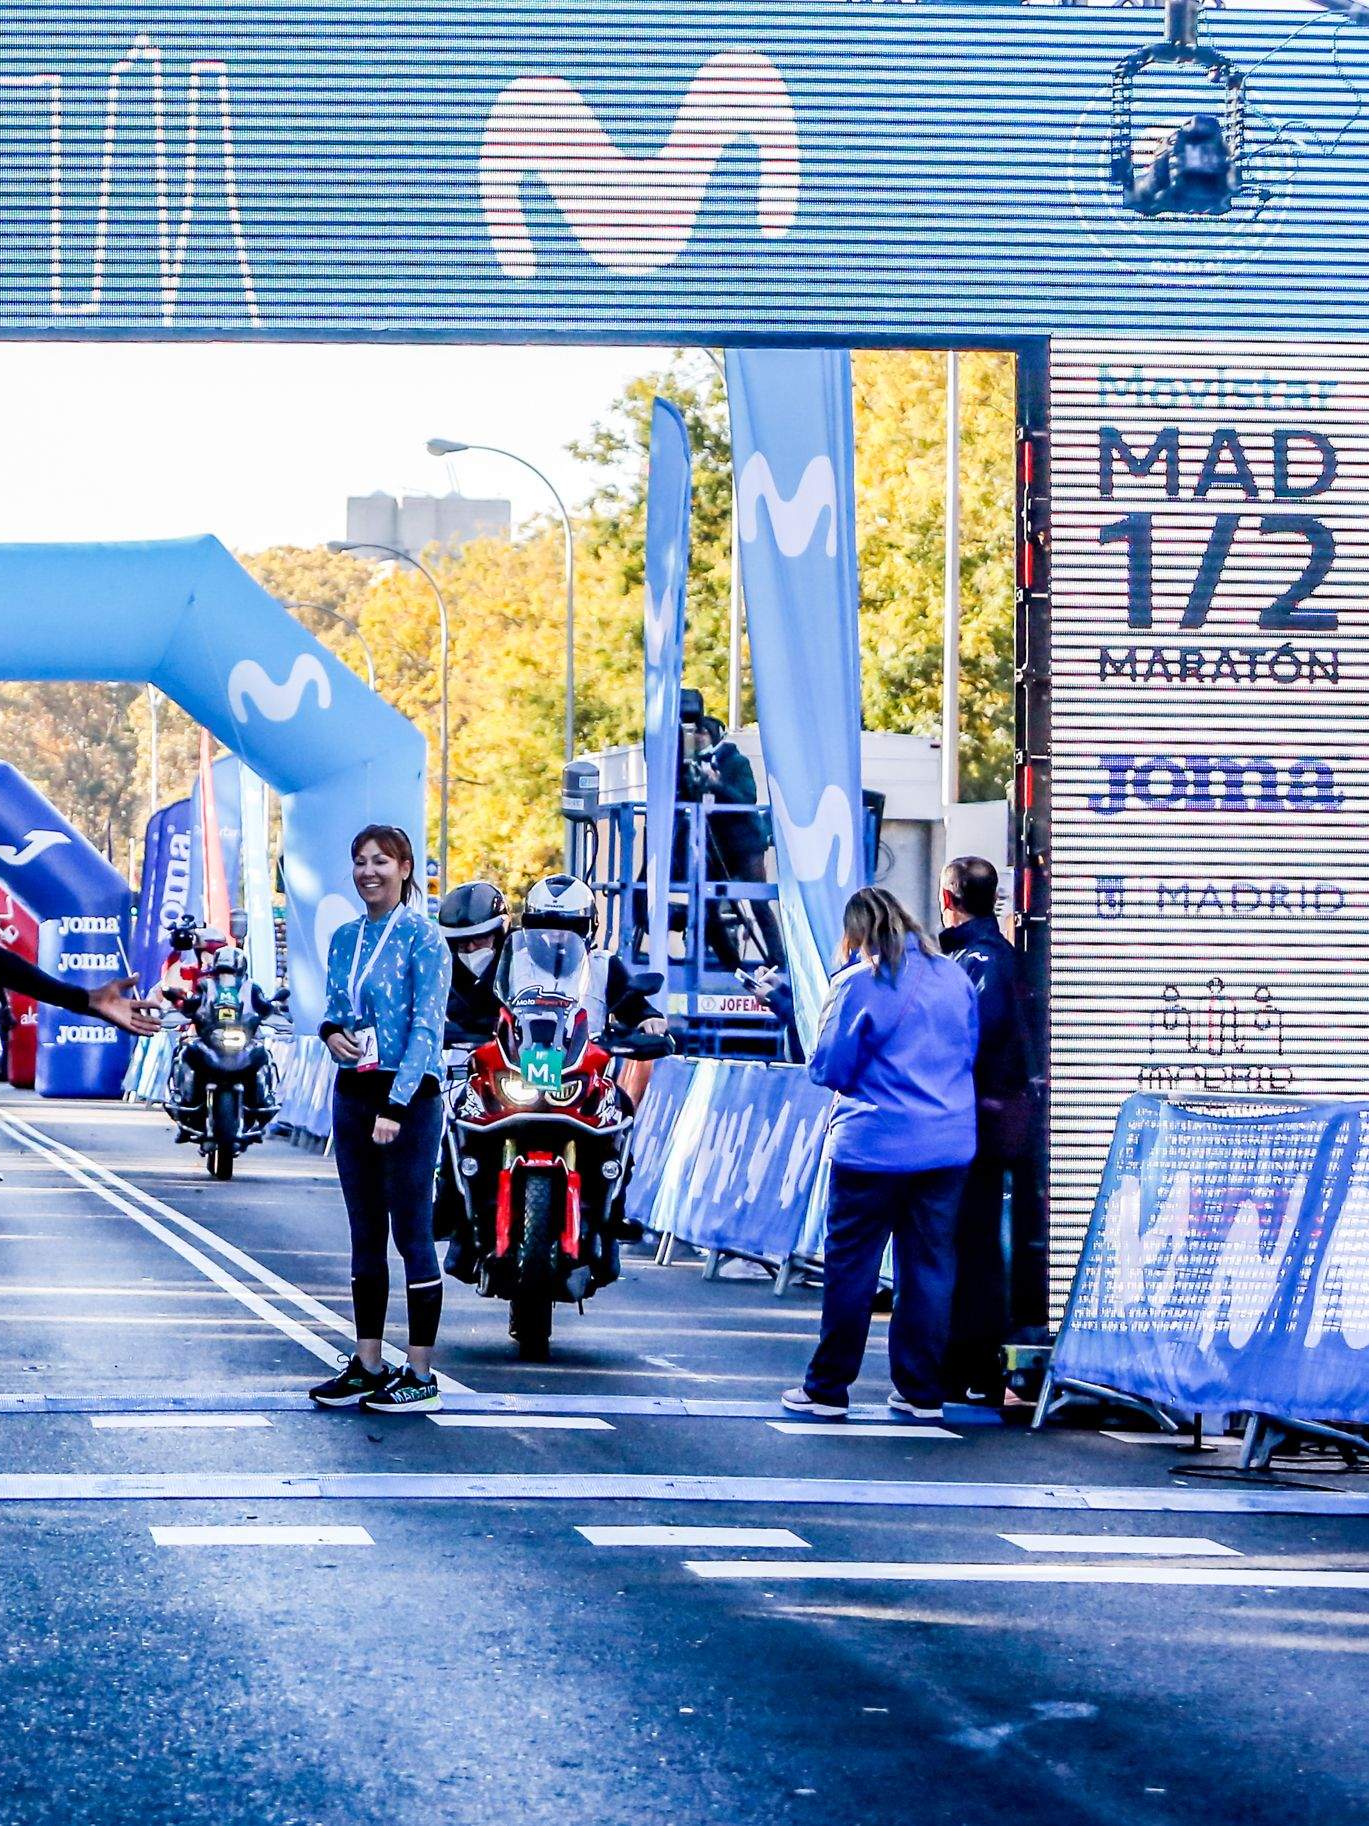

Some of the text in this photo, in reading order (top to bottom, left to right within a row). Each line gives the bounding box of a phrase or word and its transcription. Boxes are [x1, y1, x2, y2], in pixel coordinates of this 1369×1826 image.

[1098, 366, 1338, 410] Movistar
[1099, 427, 1338, 498] MAD
[1100, 511, 1338, 630] 1/2
[1099, 642, 1339, 684] MARATÓN
[1158, 882, 1345, 914] MADRID
